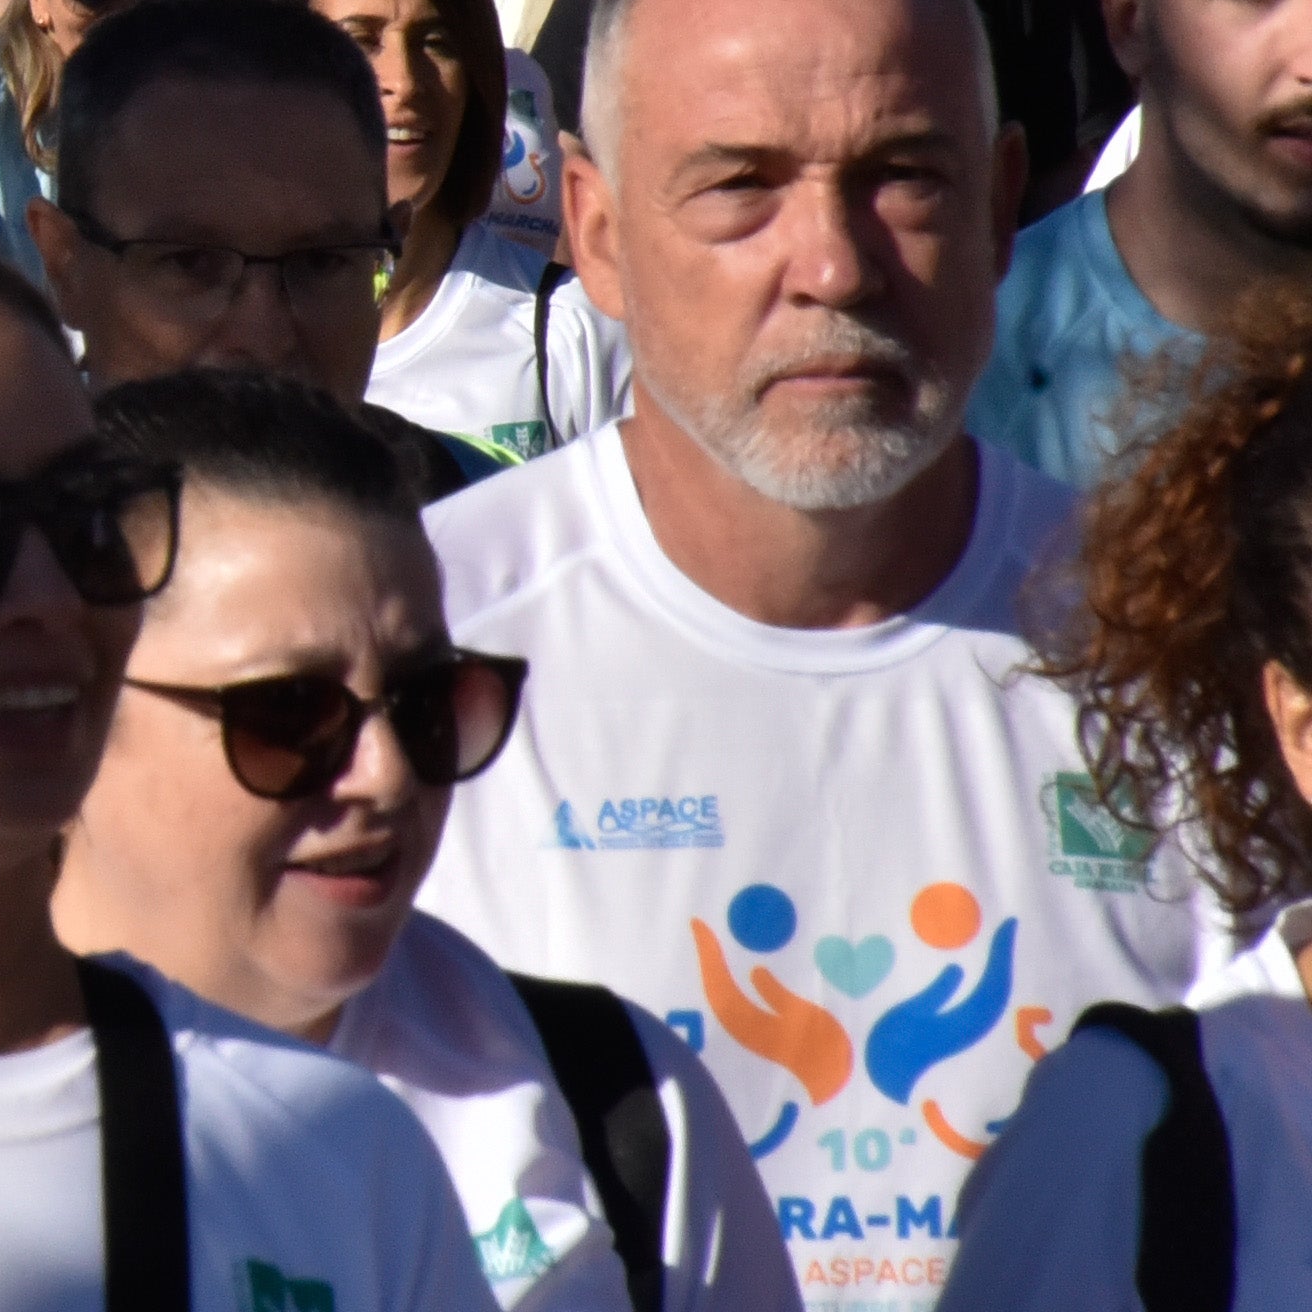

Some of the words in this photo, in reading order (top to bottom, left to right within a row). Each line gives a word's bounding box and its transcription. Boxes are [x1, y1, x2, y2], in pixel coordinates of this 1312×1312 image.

[597, 784, 718, 830] ASPACE
[778, 1195, 960, 1240] RA-M
[806, 1257, 946, 1288] ASPACE
